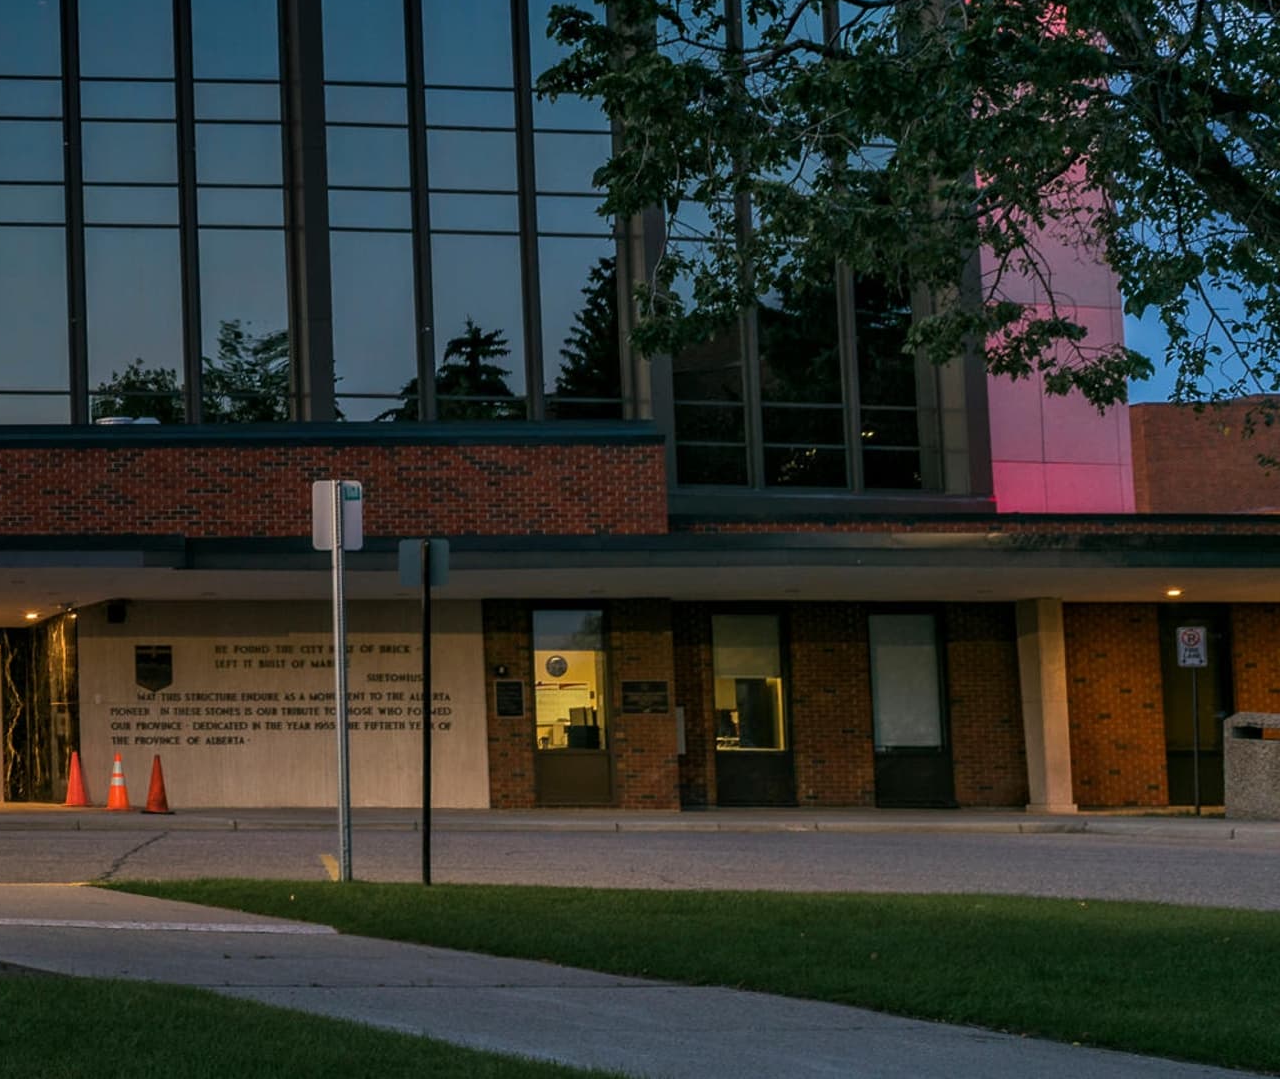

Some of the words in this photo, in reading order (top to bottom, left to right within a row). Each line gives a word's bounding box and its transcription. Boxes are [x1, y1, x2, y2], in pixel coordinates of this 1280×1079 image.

[234, 645, 269, 653] FOUND
[275, 645, 294, 653] THE
[300, 645, 323, 653] CITY
[360, 645, 375, 653] OF
[380, 645, 410, 653] BRICK
[215, 659, 237, 668] LEFT
[244, 659, 252, 668] IT
[259, 659, 285, 668] BUILT
[291, 660, 306, 668] OF
[367, 673, 423, 682] SUETONIUS
[161, 692, 181, 700] THIS
[185, 692, 237, 700] STRUCTURE
[241, 692, 279, 700] ENDURE
[369, 692, 382, 700] TO
[387, 692, 403, 700] THE
[174, 707, 201, 715] THESE
[205, 707, 240, 715] STONES
[244, 707, 252, 715] IS
[256, 707, 277, 715] OUR
[281, 707, 319, 715] TRIBUTE
[347, 707, 372, 715] HOSE
[378, 707, 403, 715] WHO
[111, 721, 130, 730] OUR
[136, 721, 181, 730] PROVINCE
[193, 721, 248, 730] DEDICATED
[265, 721, 282, 730] THE
[288, 721, 310, 730] YEAR
[438, 721, 451, 730] OF
[112, 736, 129, 745] THE
[135, 736, 179, 745] PROVINCE
[187, 736, 200, 745] OF
[205, 736, 245, 745] ALBERTA
